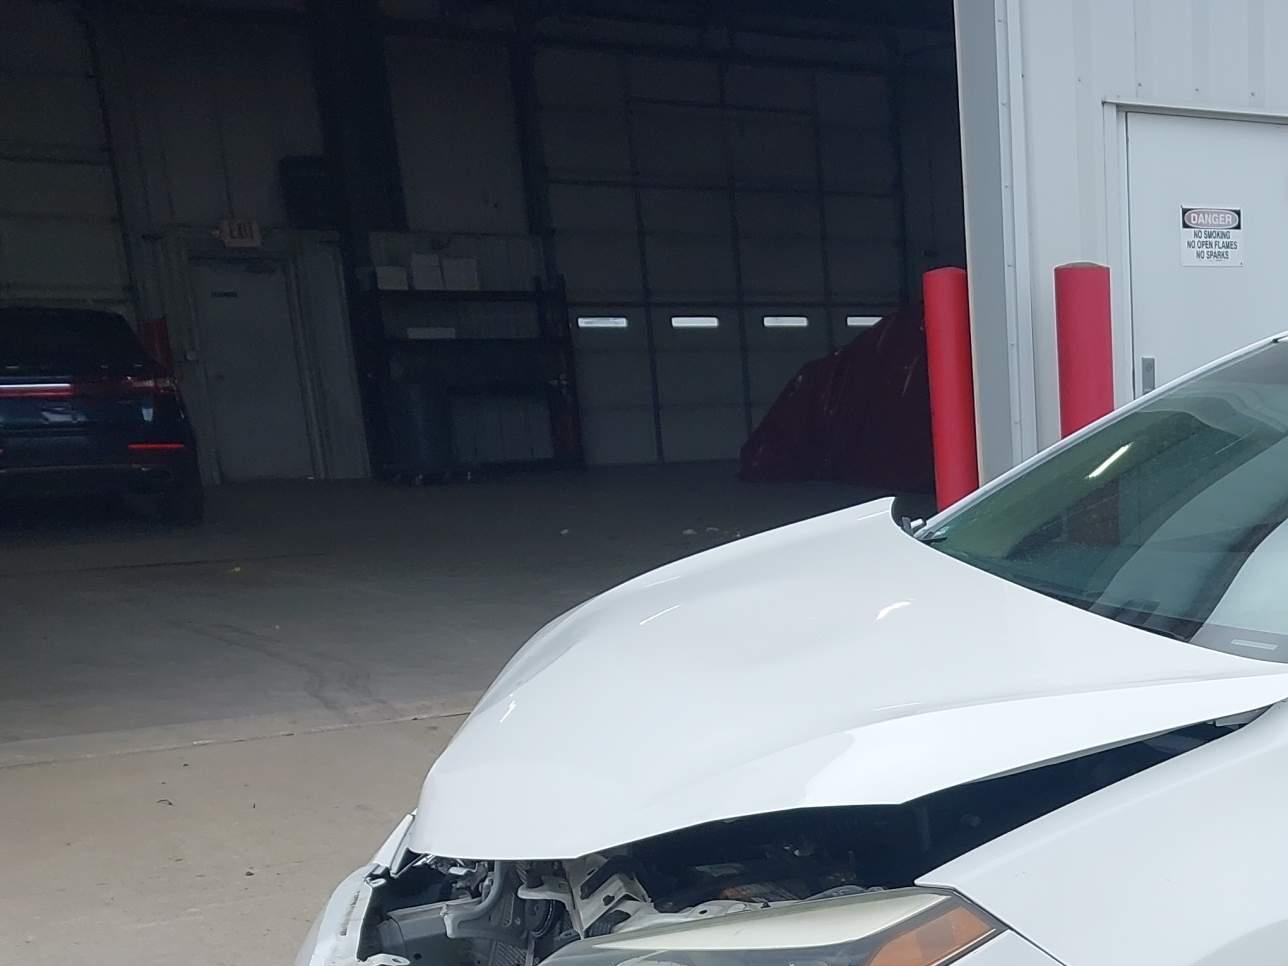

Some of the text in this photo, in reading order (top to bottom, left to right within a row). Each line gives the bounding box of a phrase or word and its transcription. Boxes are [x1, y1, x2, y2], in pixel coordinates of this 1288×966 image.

[1191, 213, 1232, 224] DANGER
[229, 223, 255, 240] EXIT
[1193, 231, 1230, 239] NO SMOKING
[1187, 240, 1237, 249] NO OPEN FLAMES
[1196, 250, 1229, 259] NO SPARKS
